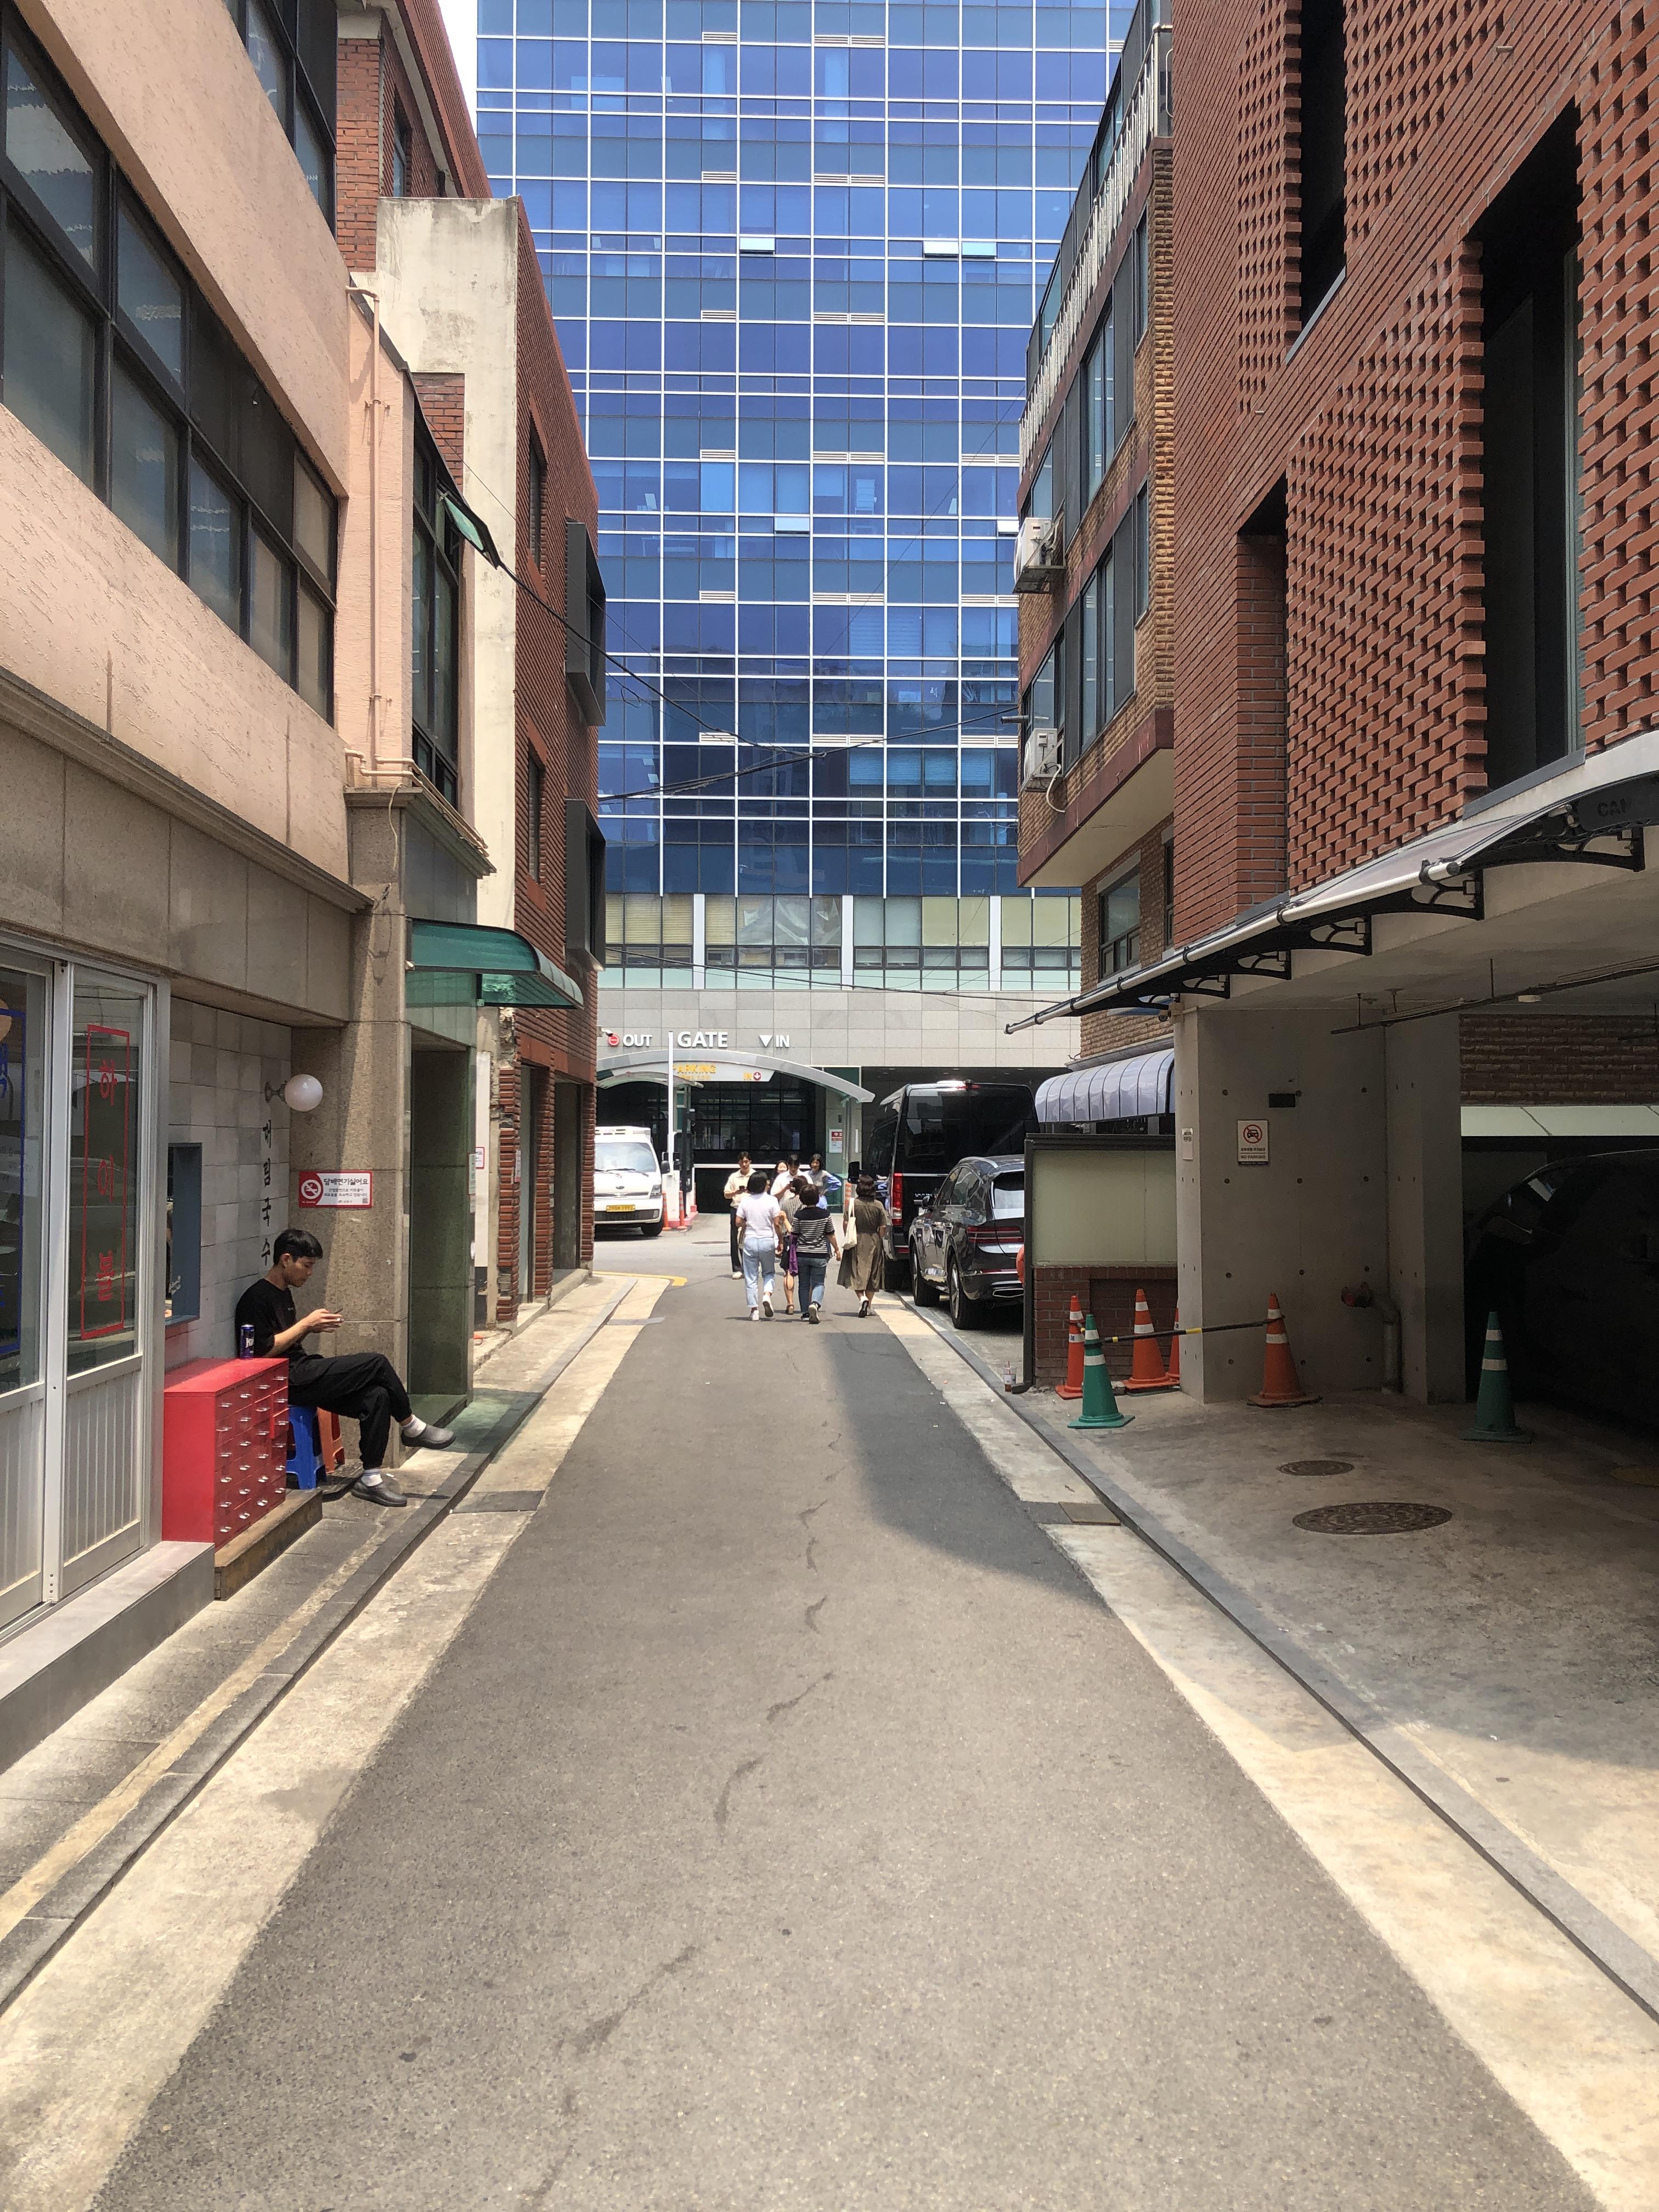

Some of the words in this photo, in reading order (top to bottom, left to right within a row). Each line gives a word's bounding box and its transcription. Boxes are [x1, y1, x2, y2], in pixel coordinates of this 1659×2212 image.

[623, 1034, 652, 1047] OUT
[677, 1031, 728, 1047] GATE
[776, 1035, 790, 1047] IN
[97, 1059, 117, 1302] 하이볼
